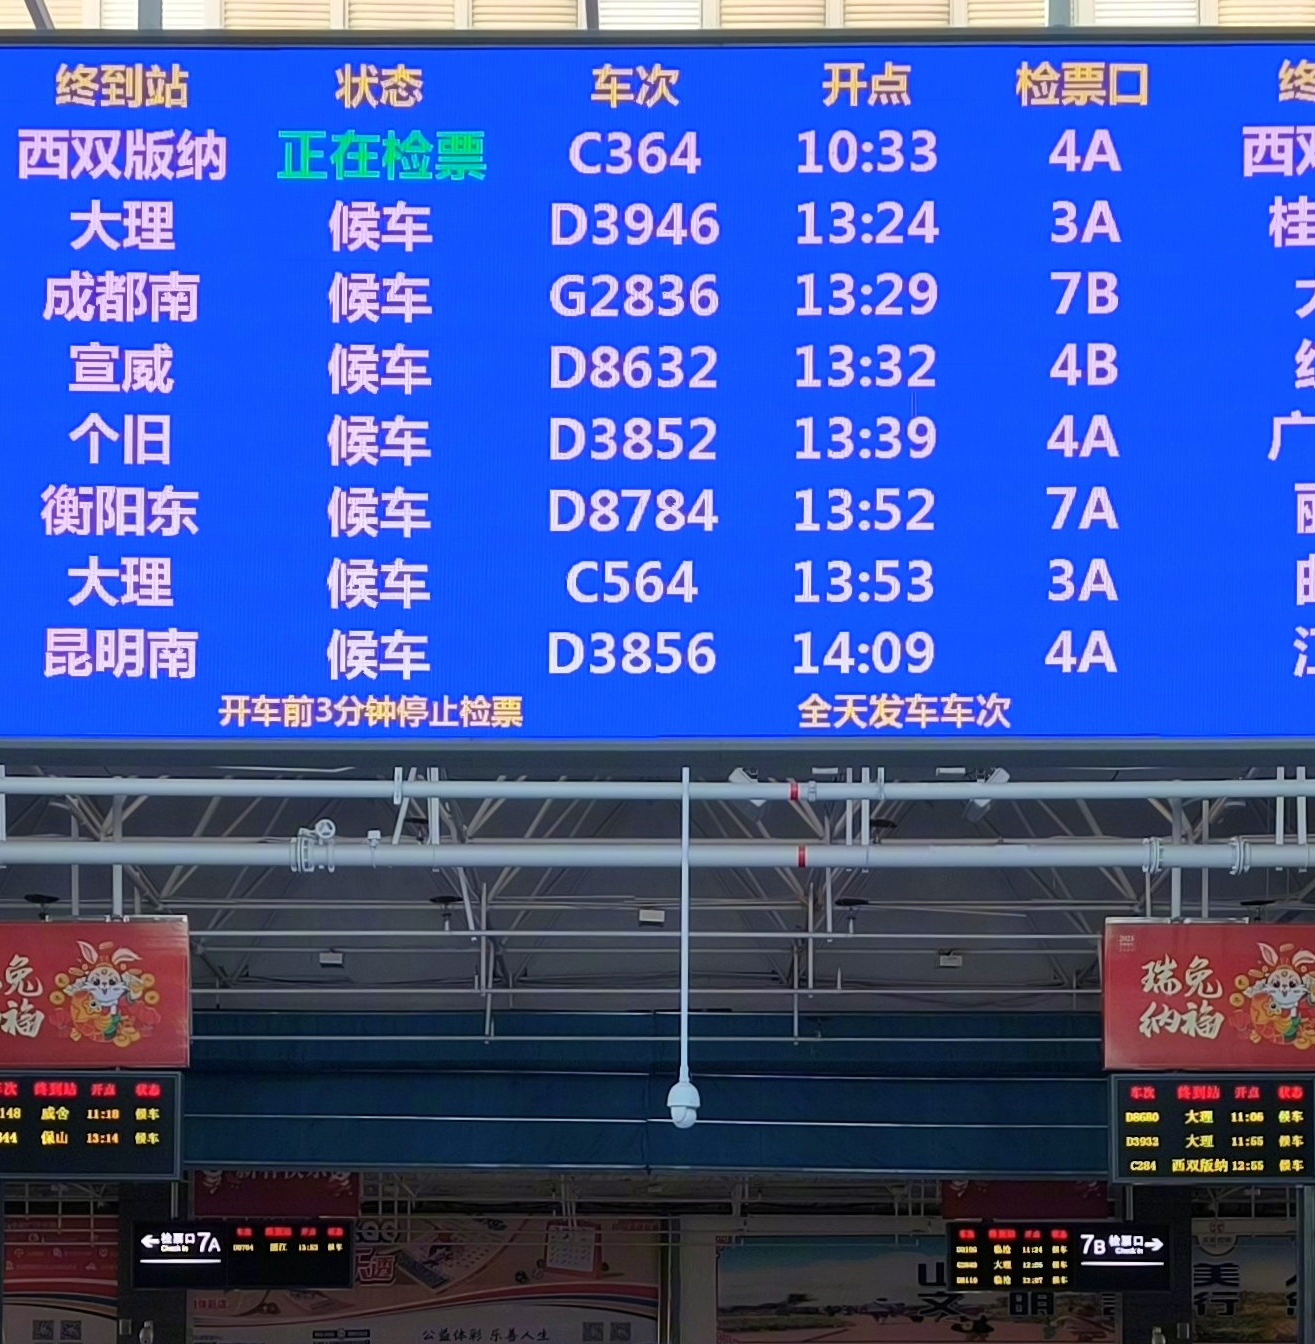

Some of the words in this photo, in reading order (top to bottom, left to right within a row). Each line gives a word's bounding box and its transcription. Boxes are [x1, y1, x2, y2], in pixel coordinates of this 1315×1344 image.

[55, 63, 189, 109] 终到站
[335, 63, 423, 109] 状态
[590, 63, 680, 109] 车次
[822, 61, 912, 107] 开点
[1015, 61, 1148, 107] 检票口
[18, 128, 227, 181] 西双版纳
[276, 129, 488, 181] 正在检票
[569, 131, 702, 175] C364
[797, 129, 937, 173] 10:33
[1048, 129, 1122, 172] 4A
[70, 199, 176, 251] 大理
[328, 200, 433, 252] 候车
[551, 202, 720, 246] D3946
[797, 200, 940, 245] 13:24
[1051, 200, 1121, 243] 3A
[42, 270, 201, 323] 成都南
[328, 271, 433, 324] 候车
[549, 273, 719, 317] G2836
[796, 272, 938, 316] 13:29
[1050, 271, 1119, 315] 7B
[68, 341, 175, 394] 宣威
[327, 342, 432, 395] 候车
[550, 345, 717, 389] D8632
[796, 344, 936, 388] 13:32
[1049, 342, 1118, 386] 4B
[69, 412, 171, 465] 个旧
[327, 414, 432, 467] 候车
[549, 417, 717, 461] D3852
[795, 416, 937, 460] 13:39
[1046, 414, 1120, 458] 4A
[40, 484, 199, 537] 衡阳东
[327, 485, 432, 538] 候车
[549, 488, 719, 532] D8784
[795, 487, 935, 532] 13:52
[1046, 486, 1119, 530] 7A
[67, 555, 174, 607] 大理
[326, 557, 431, 610] 候车
[566, 560, 699, 603] C564
[794, 559, 934, 603] 13:53
[1048, 558, 1119, 602] 3A
[43, 627, 199, 680] 昆明南
[326, 628, 431, 681] 候车
[548, 631, 716, 674] D3856
[793, 631, 935, 674] 14:09
[1044, 630, 1118, 673] 4A
[218, 694, 524, 728] 开车前3分钟停止检票
[797, 692, 1011, 729] 全天发车车次
[1141, 953, 1223, 999] 瑞兔
[196, 1231, 222, 1253] 7A
